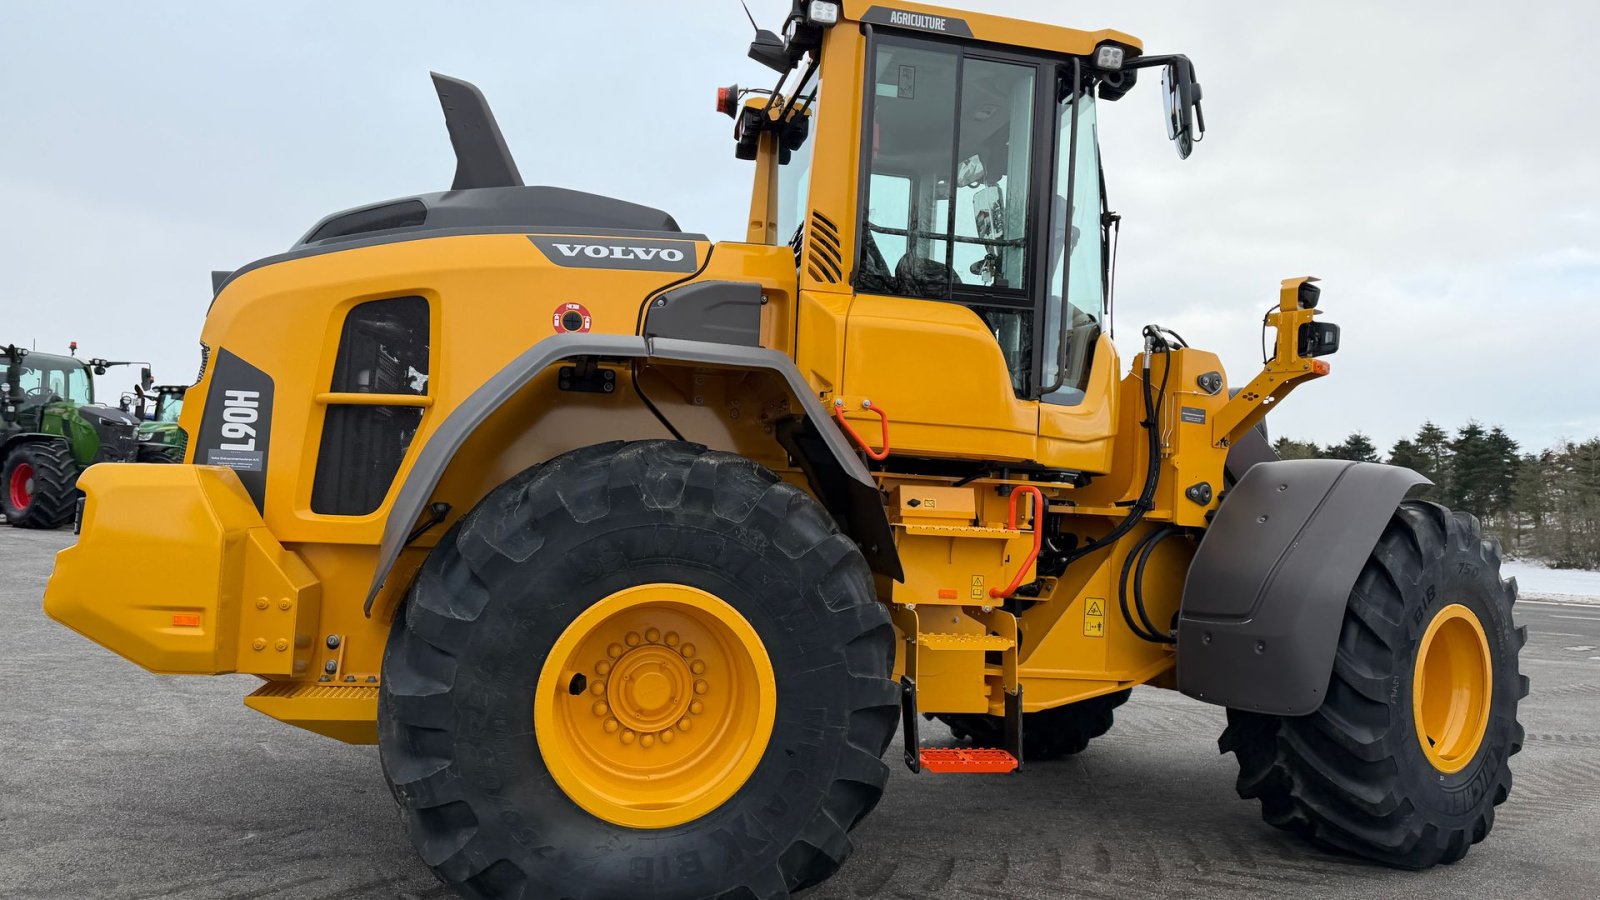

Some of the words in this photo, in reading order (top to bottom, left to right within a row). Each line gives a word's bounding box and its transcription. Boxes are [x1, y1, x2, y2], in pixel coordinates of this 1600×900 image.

[890, 11, 946, 30] AGRICULTURE
[552, 243, 684, 262] VOLVO
[220, 390, 260, 451] L90H
